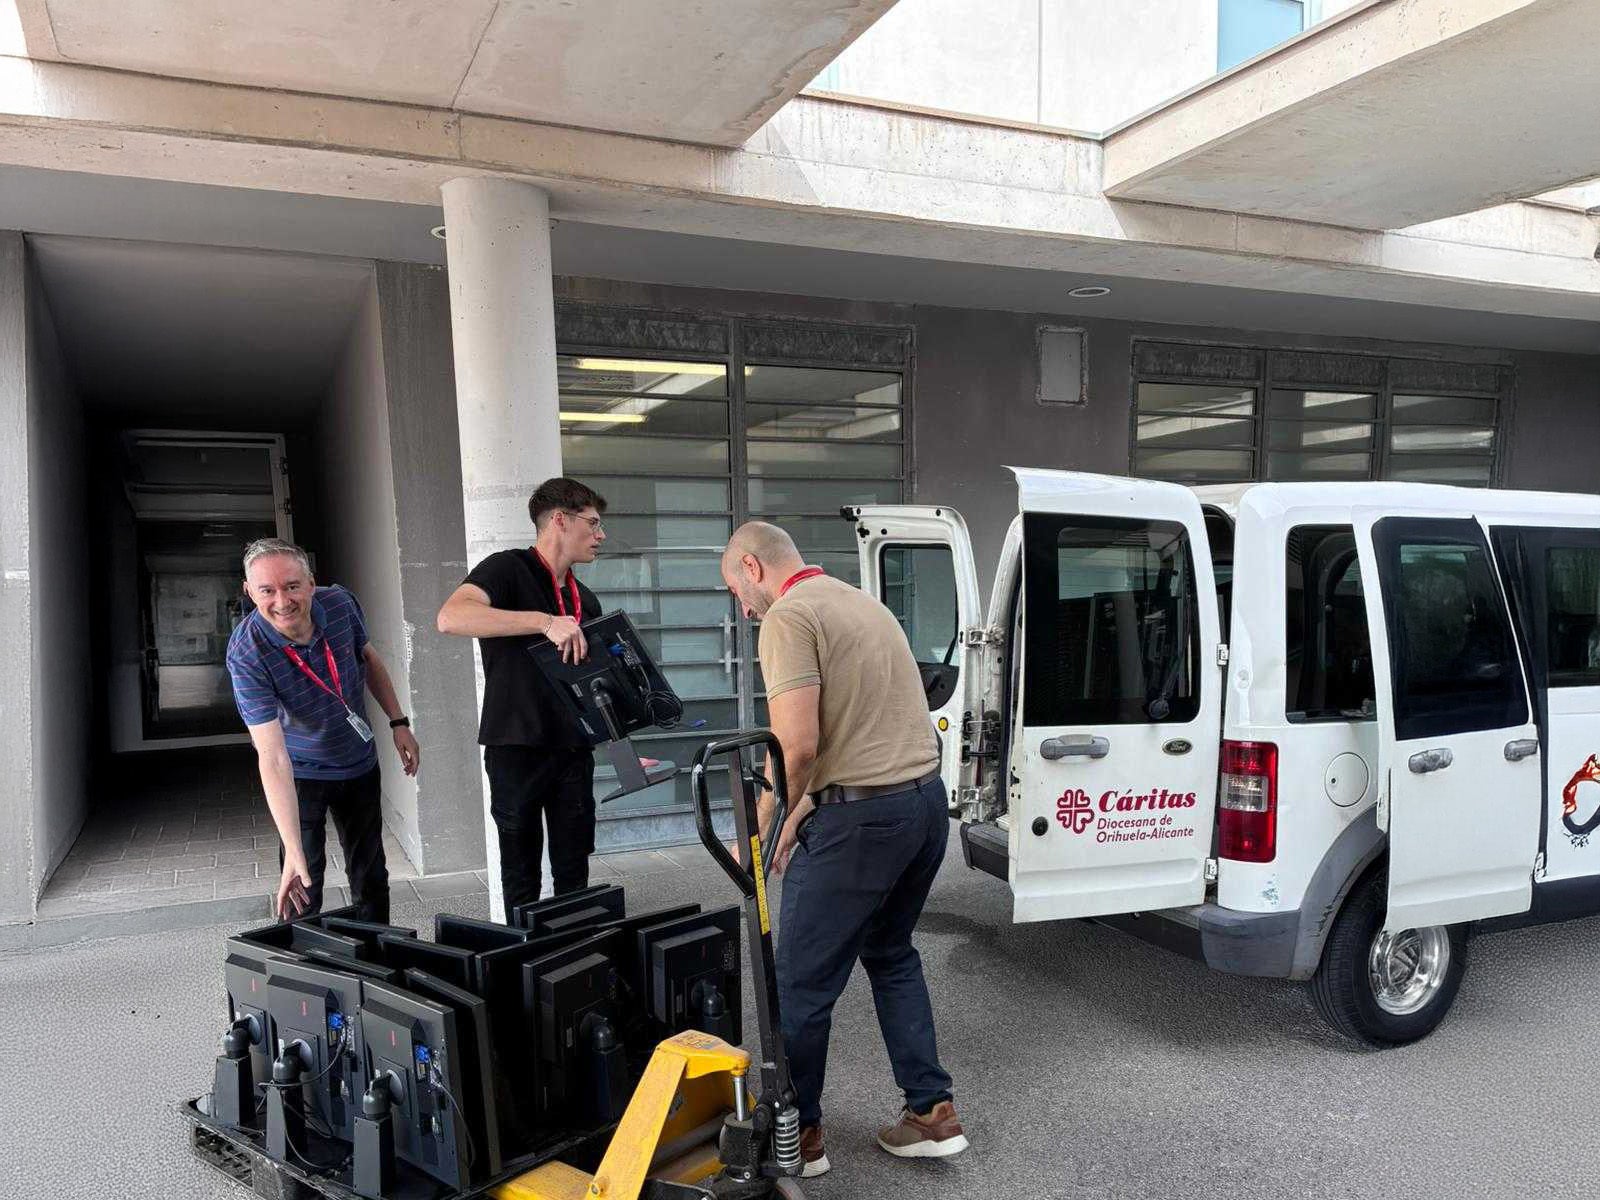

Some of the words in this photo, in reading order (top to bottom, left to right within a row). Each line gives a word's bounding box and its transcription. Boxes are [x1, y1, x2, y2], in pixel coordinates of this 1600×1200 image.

[1098, 788, 1197, 812] Cáritas
[1096, 817, 1156, 830] Diocesana
[1159, 814, 1173, 826] de
[1096, 828, 1195, 843] Orihuela-Alicante
